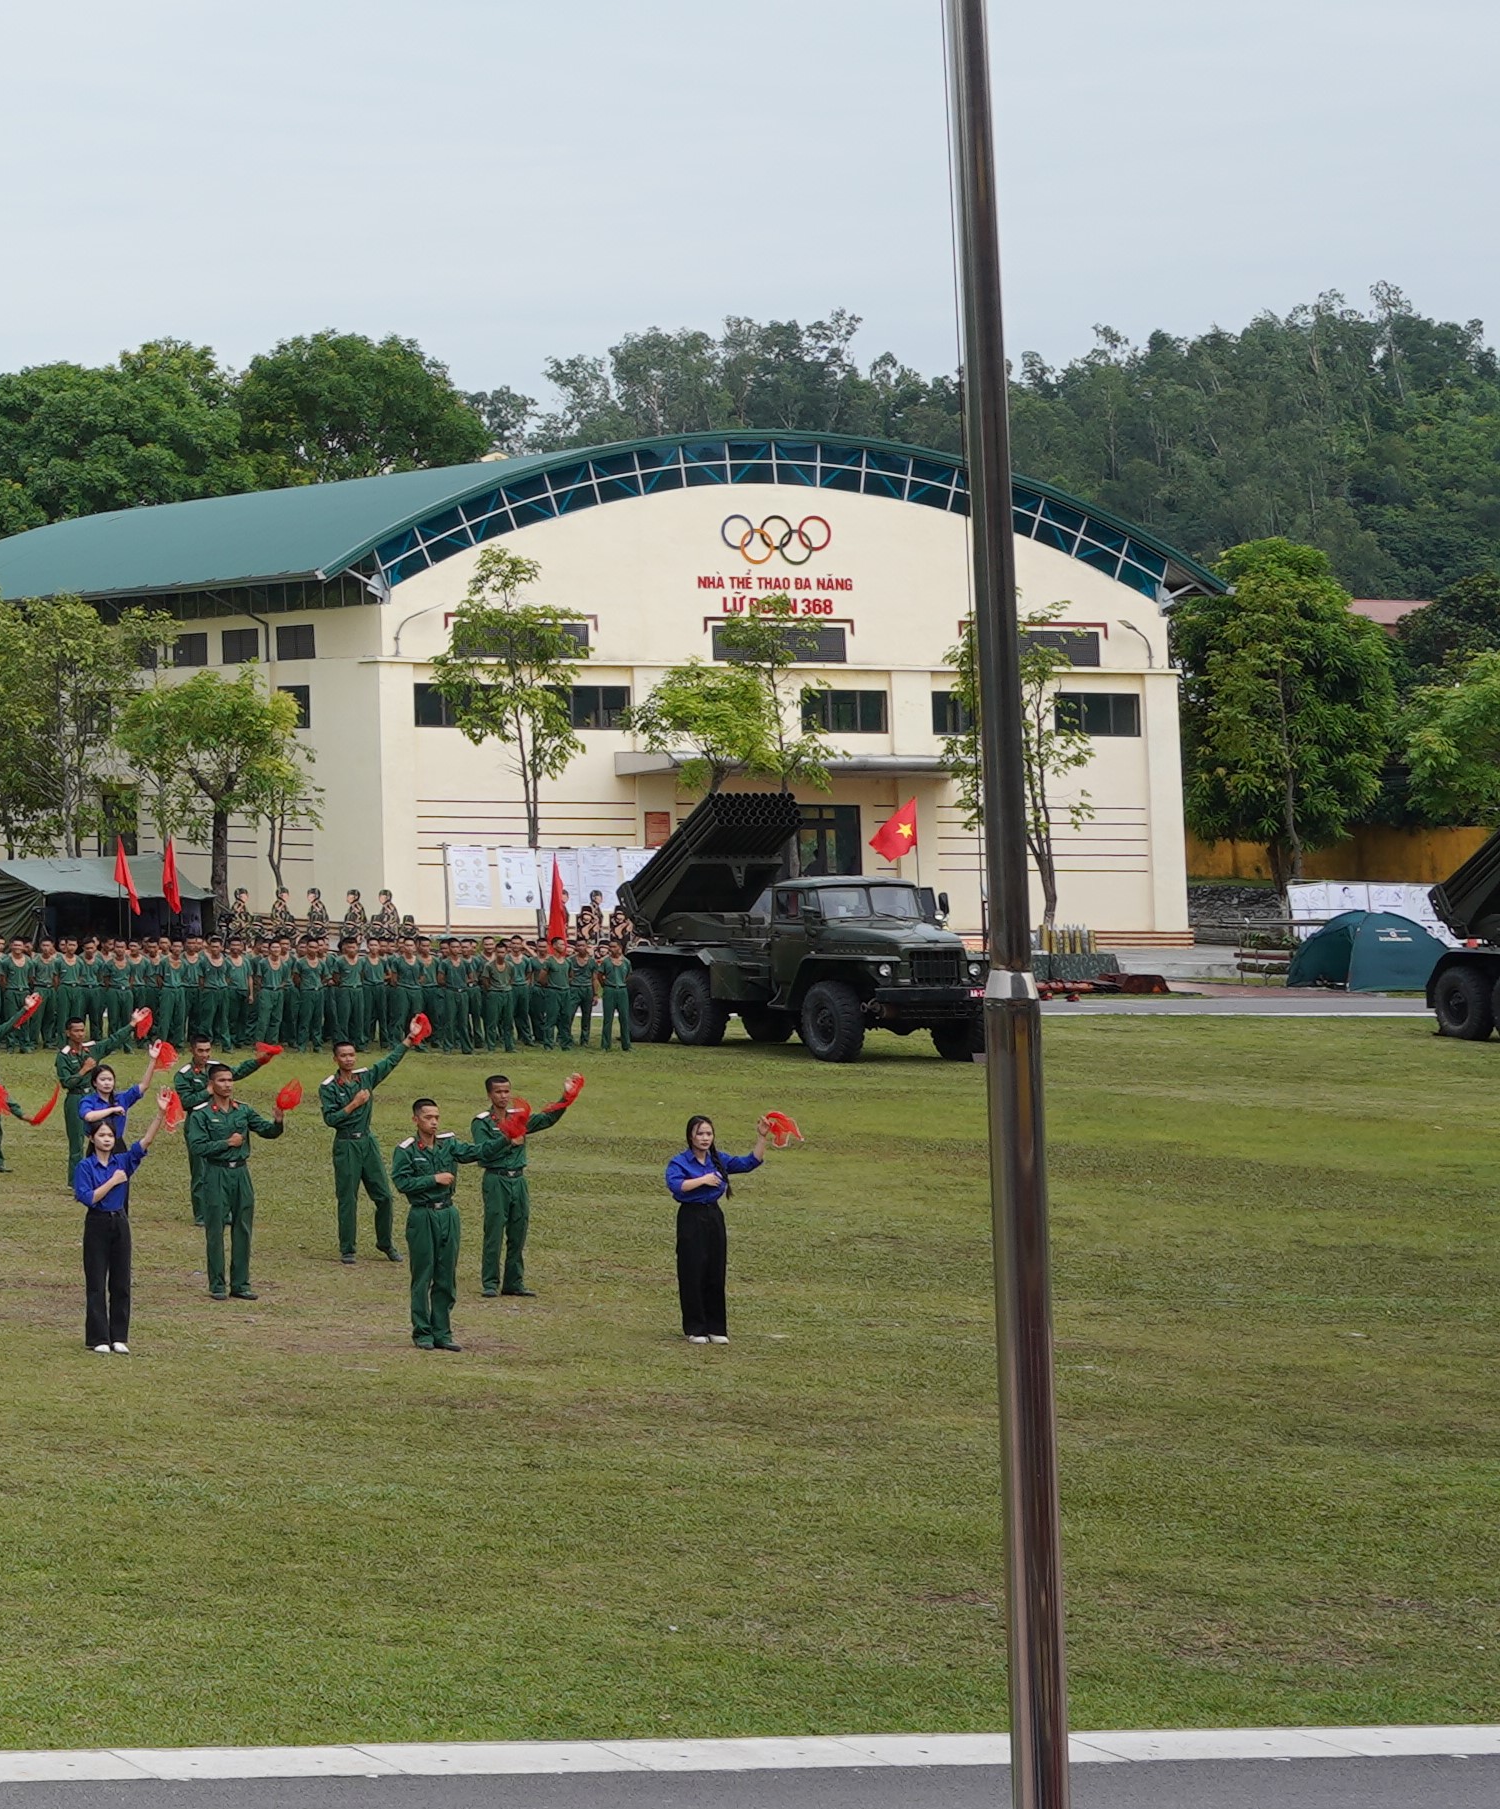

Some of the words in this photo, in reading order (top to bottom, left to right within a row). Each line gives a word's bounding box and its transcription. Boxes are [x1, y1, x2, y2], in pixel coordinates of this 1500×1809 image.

[697, 571, 725, 589] NHÀ
[729, 569, 752, 589] THỂ
[757, 577, 790, 590] THAO
[794, 577, 812, 590] ĐA
[816, 574, 853, 591] NĂNG
[723, 591, 746, 613] LỮ
[801, 598, 833, 614] 368
